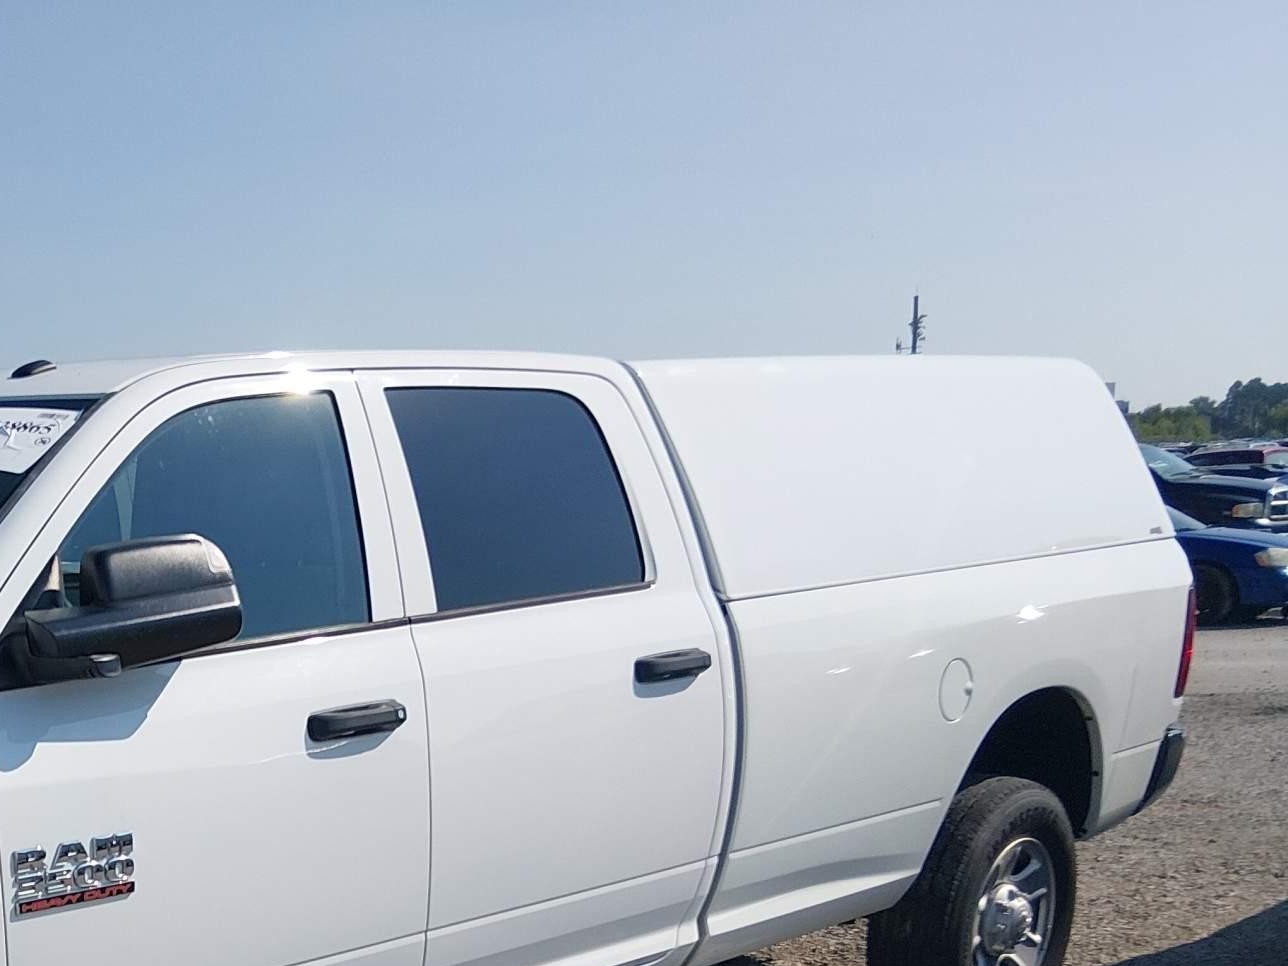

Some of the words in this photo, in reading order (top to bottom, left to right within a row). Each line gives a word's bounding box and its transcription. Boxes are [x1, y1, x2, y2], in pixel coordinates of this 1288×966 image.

[11, 833, 134, 878] RAM
[21, 893, 81, 912] HEAVY
[83, 883, 132, 901] DUTY
